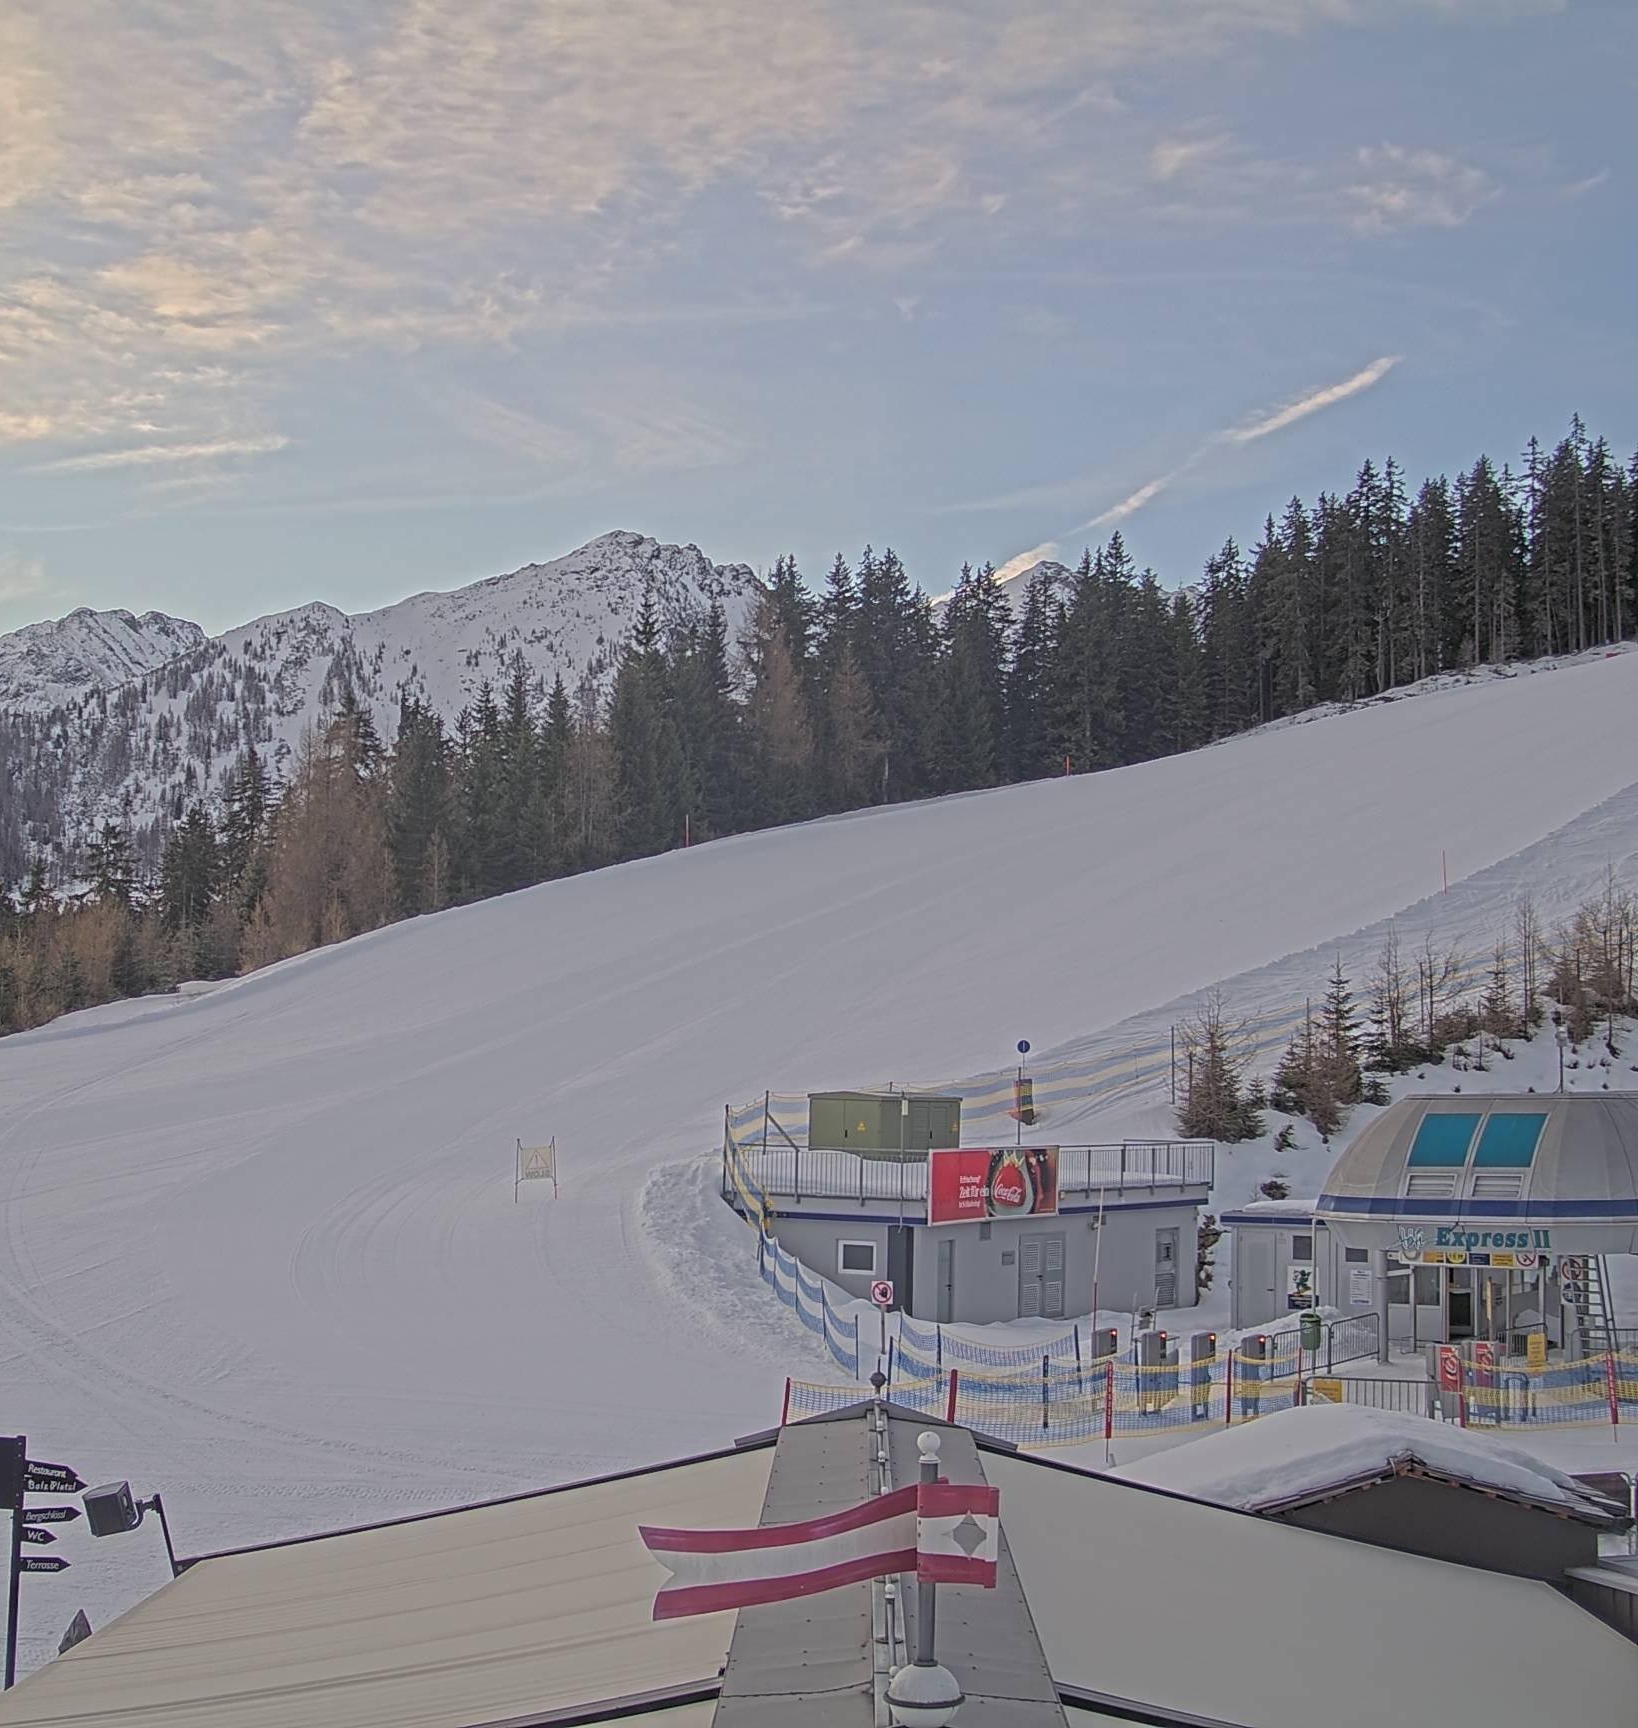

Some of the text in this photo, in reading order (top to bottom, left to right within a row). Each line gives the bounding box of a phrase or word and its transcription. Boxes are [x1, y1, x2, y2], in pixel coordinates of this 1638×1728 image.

[1436, 1227, 1529, 1251] Express
[1533, 1229, 1551, 1249] II
[27, 1529, 45, 1541] WC
[27, 1560, 60, 1570] Terrasse
